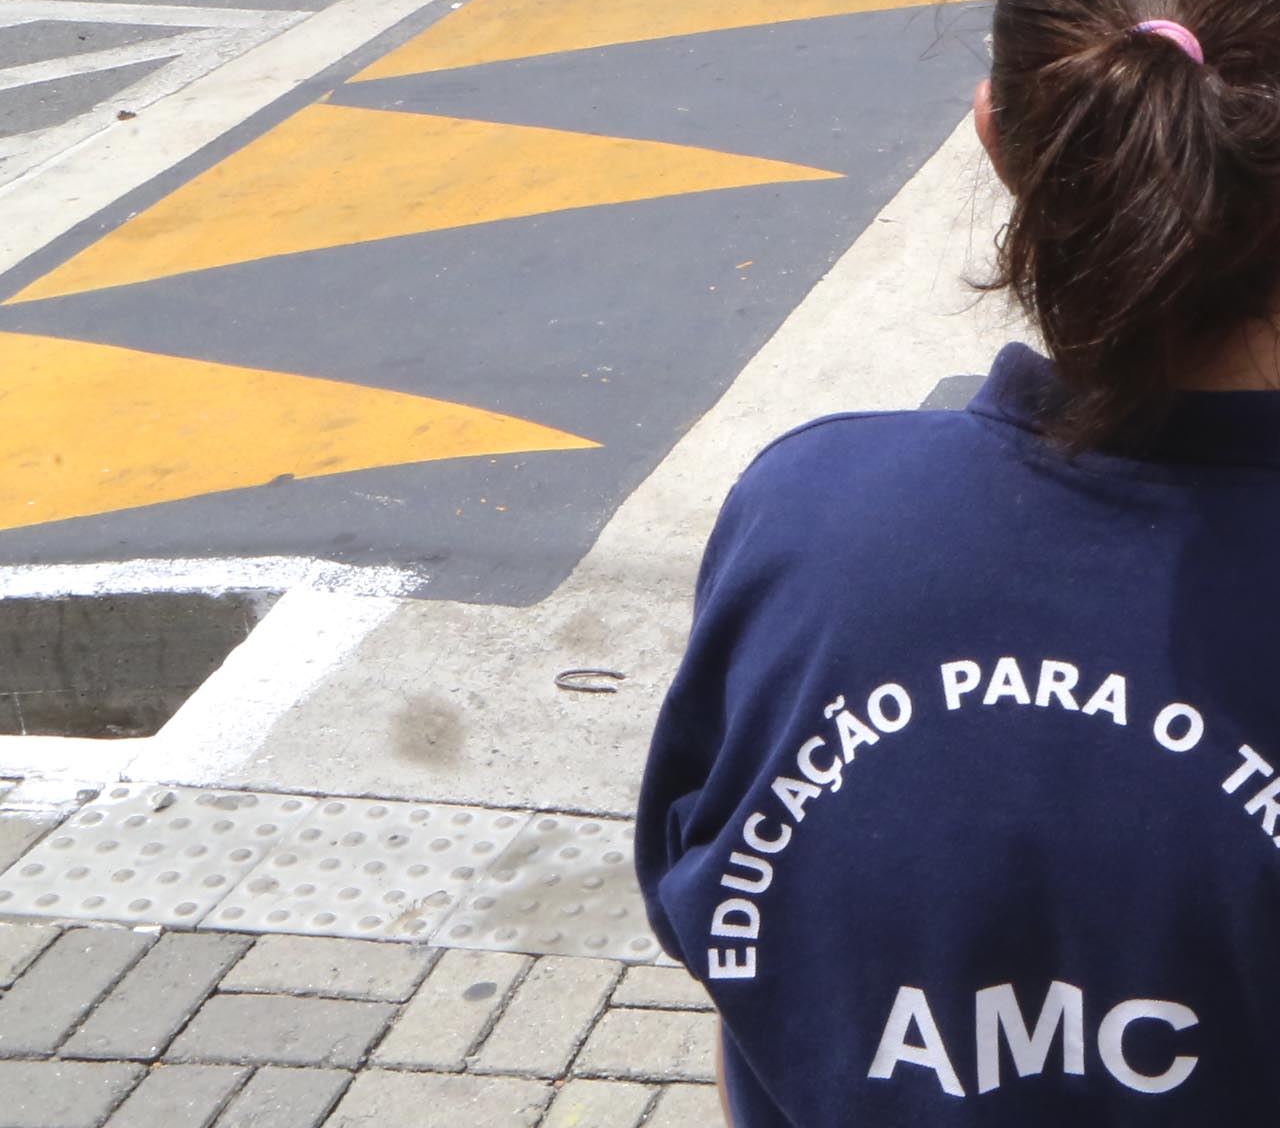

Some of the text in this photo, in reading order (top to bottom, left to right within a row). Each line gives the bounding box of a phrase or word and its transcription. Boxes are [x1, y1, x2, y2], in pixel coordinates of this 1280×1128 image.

[707, 683, 913, 980] EDUCAÇÃO
[940, 656, 1128, 726] PARA
[1152, 703, 1205, 753] O
[867, 980, 1200, 1098] AMC
